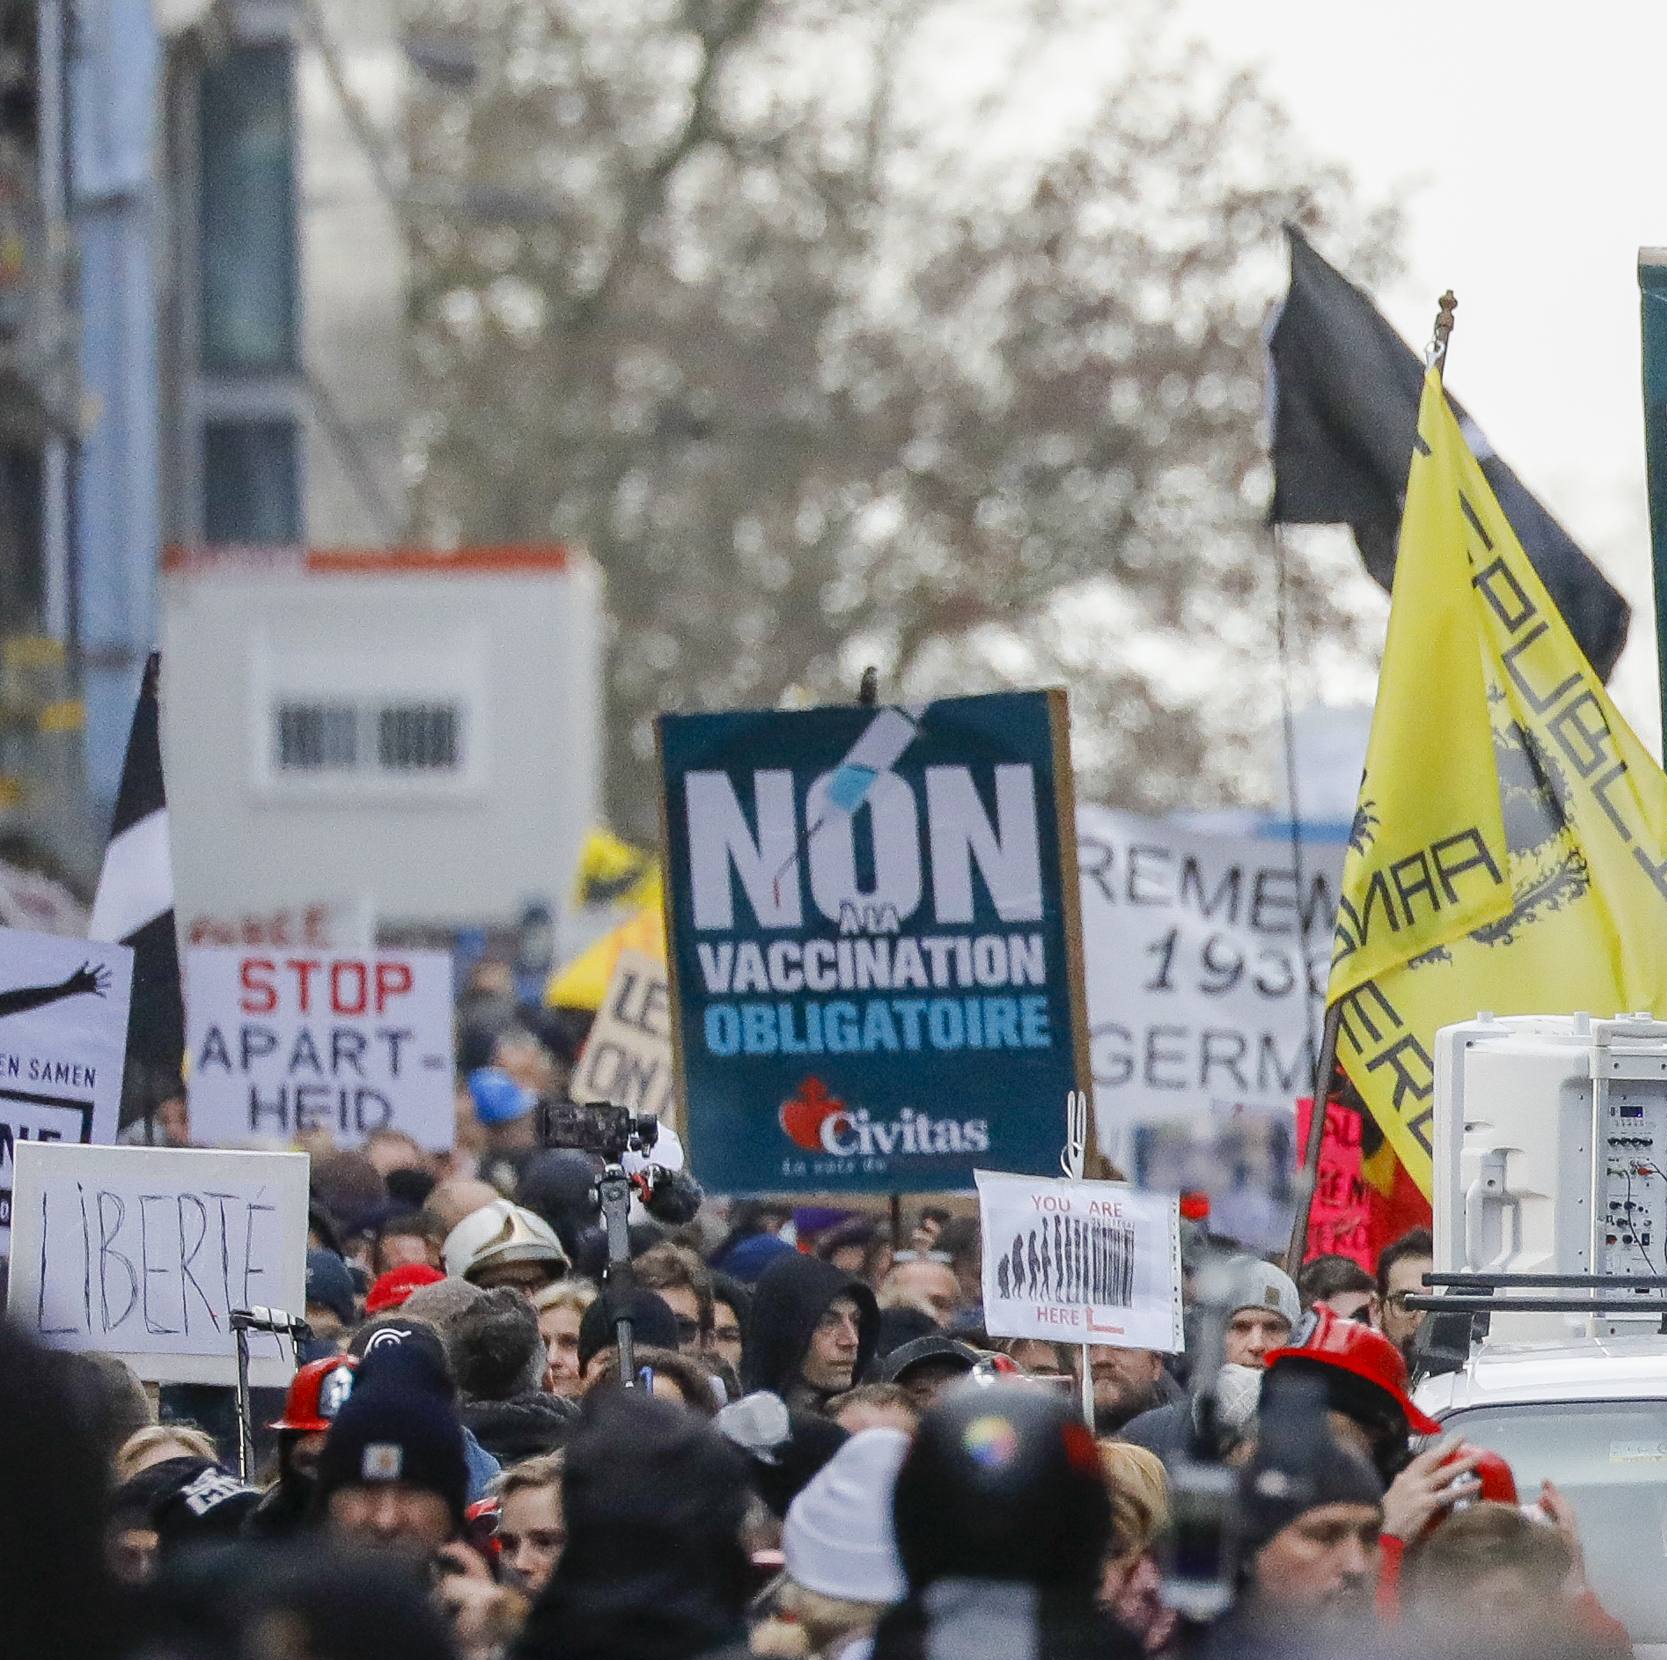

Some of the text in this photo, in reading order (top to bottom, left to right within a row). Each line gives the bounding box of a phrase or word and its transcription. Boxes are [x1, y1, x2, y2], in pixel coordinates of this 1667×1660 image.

[684, 764, 1044, 931] NON
[239, 959, 414, 1016] STOP
[698, 936, 1045, 994] VACCINATION
[198, 1022, 446, 1078] APART-
[704, 998, 1051, 1056] OBLIGATOIRE
[28, 1059, 96, 1088] SAMEN
[249, 1083, 394, 1132] HEID
[821, 1111, 989, 1155] Civitas
[1032, 1196, 1122, 1217] YOU ARE
[38, 1181, 277, 1338] LIBERTÉ
[1036, 1306, 1079, 1325] HERE
